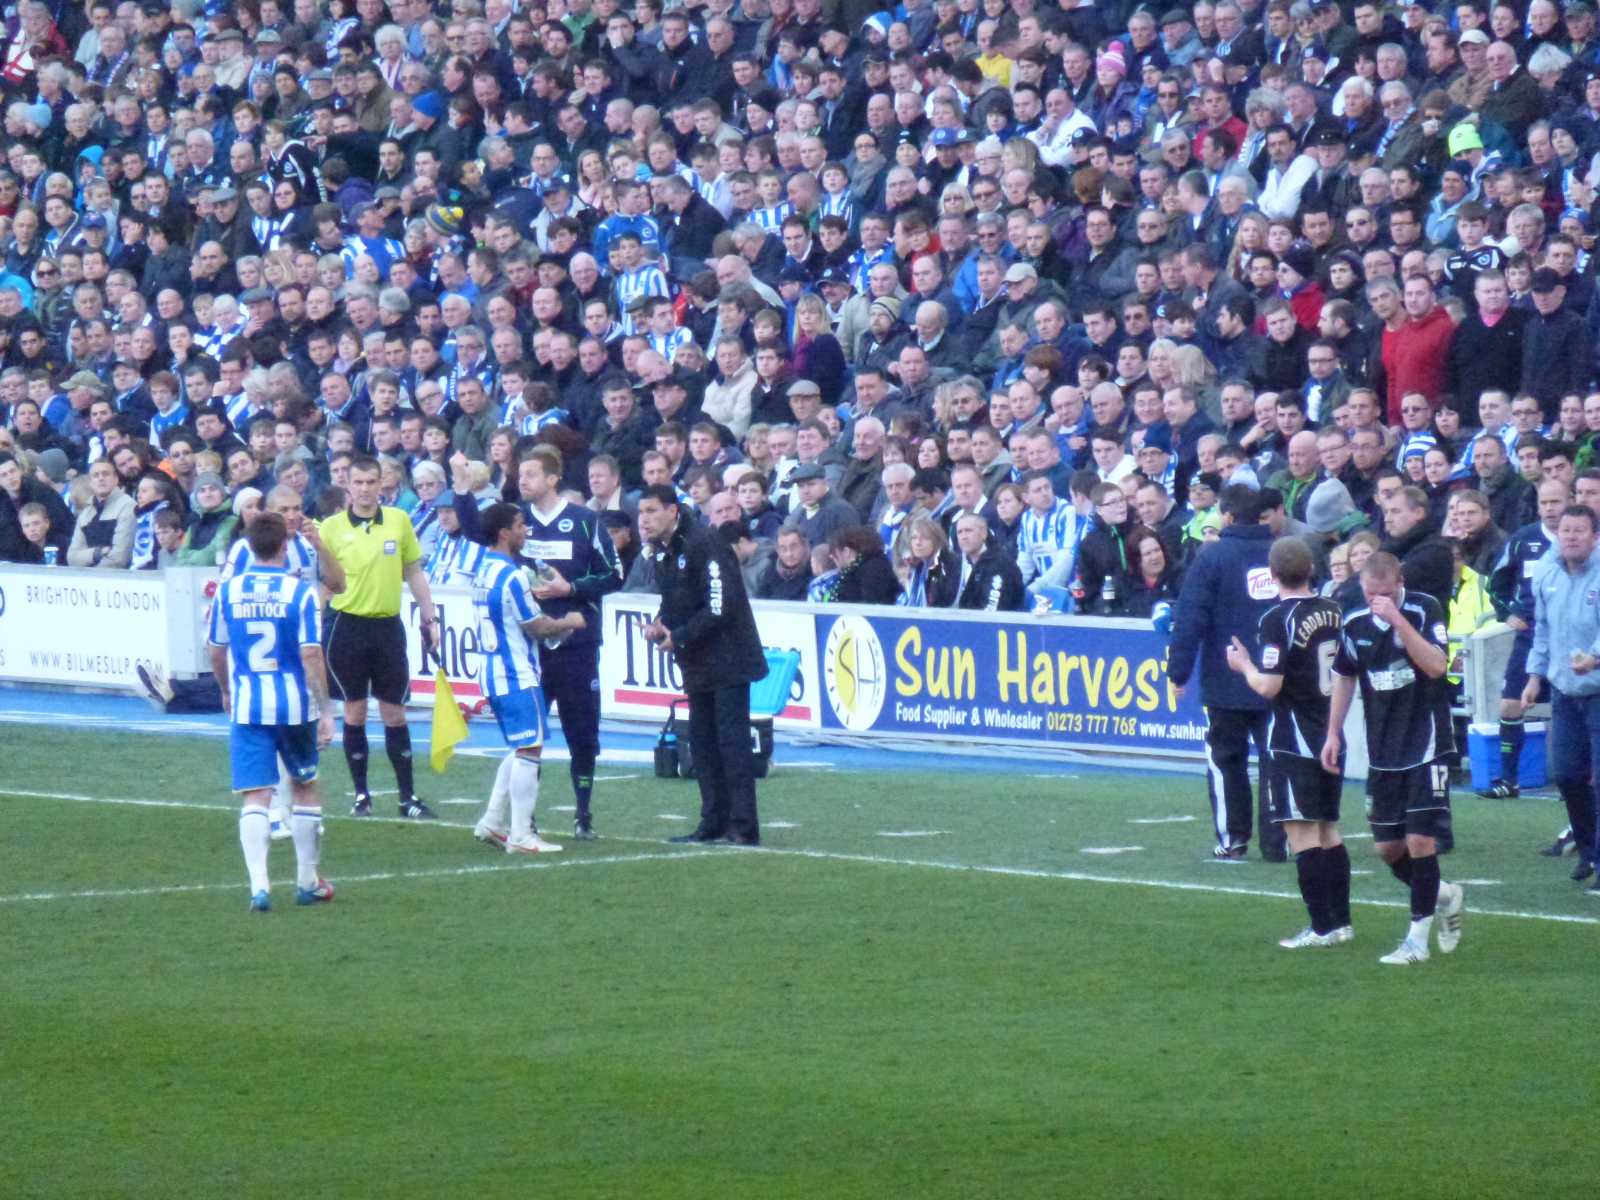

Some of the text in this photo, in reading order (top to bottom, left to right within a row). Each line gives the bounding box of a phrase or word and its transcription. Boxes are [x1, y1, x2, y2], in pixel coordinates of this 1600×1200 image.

[27, 585, 88, 607] BRIGHTON
[107, 590, 160, 611] LONDON
[232, 602, 288, 619] MATTOCK
[246, 621, 278, 673] 2
[895, 626, 976, 700] Sun
[896, 701, 921, 722] Food
[923, 704, 968, 729] Supplier
[970, 707, 981, 726] &
[984, 707, 1043, 730] Wholesaler
[1047, 711, 1083, 733] 01273
[1086, 713, 1108, 734] 777
[1112, 716, 1137, 736] 768
[1430, 764, 1449, 791] 17
